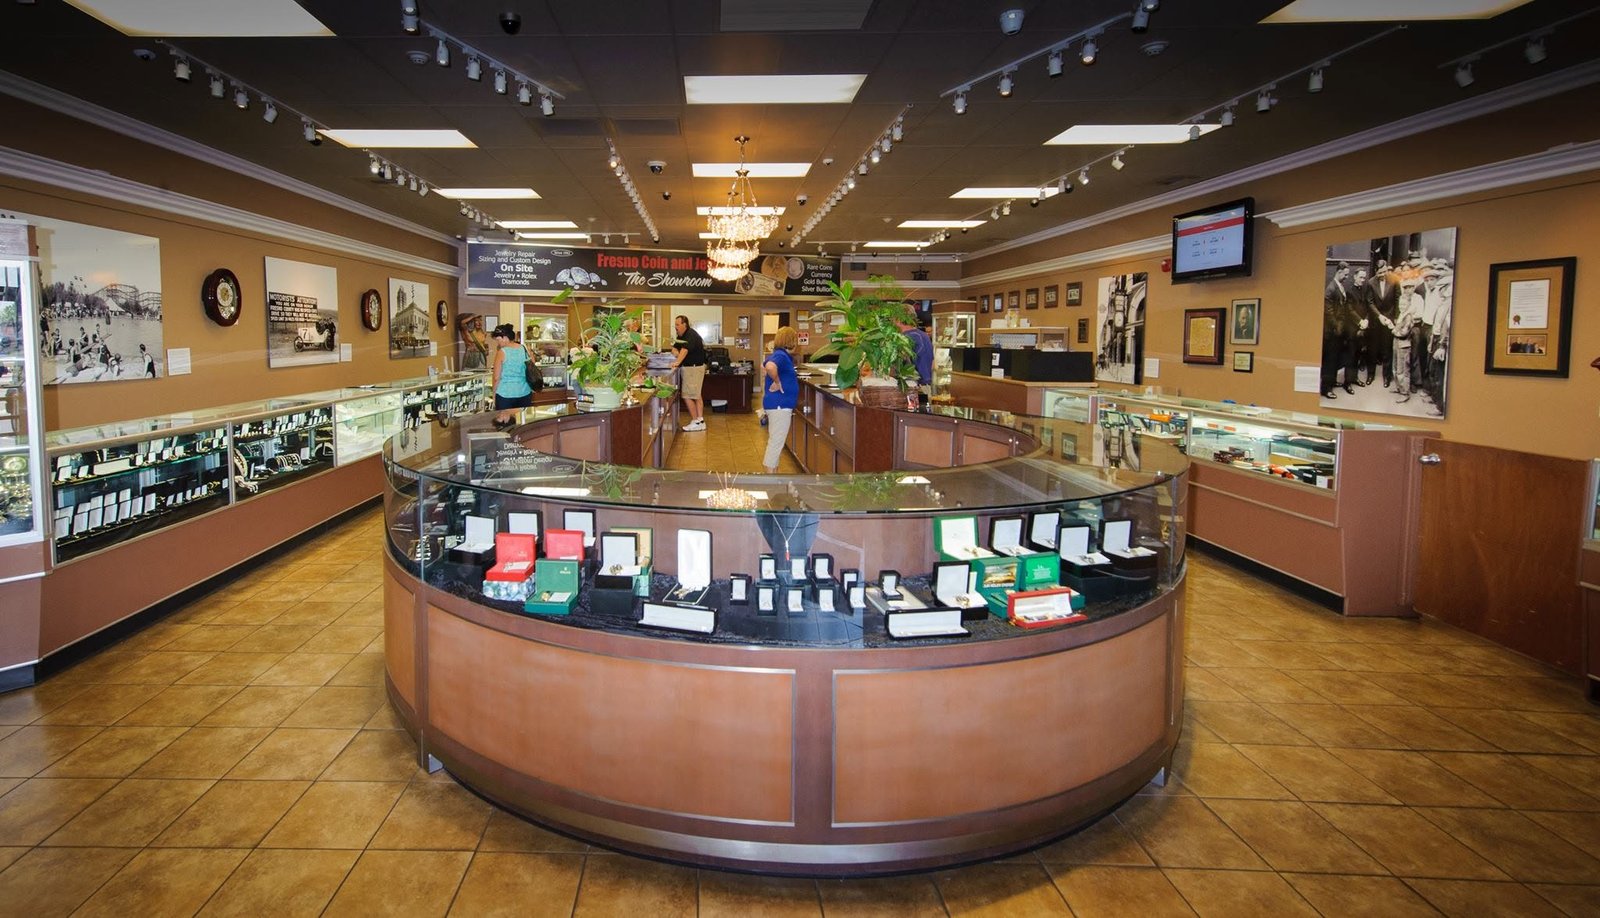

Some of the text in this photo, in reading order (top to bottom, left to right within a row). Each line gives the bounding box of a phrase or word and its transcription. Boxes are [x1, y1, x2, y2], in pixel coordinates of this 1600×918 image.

[597, 252, 639, 268] Fresno
[642, 255, 669, 268] Coin
[671, 256, 692, 270] and
[516, 264, 533, 272] Site
[647, 272, 712, 287] Showroom
[302, 329, 308, 339] 7
